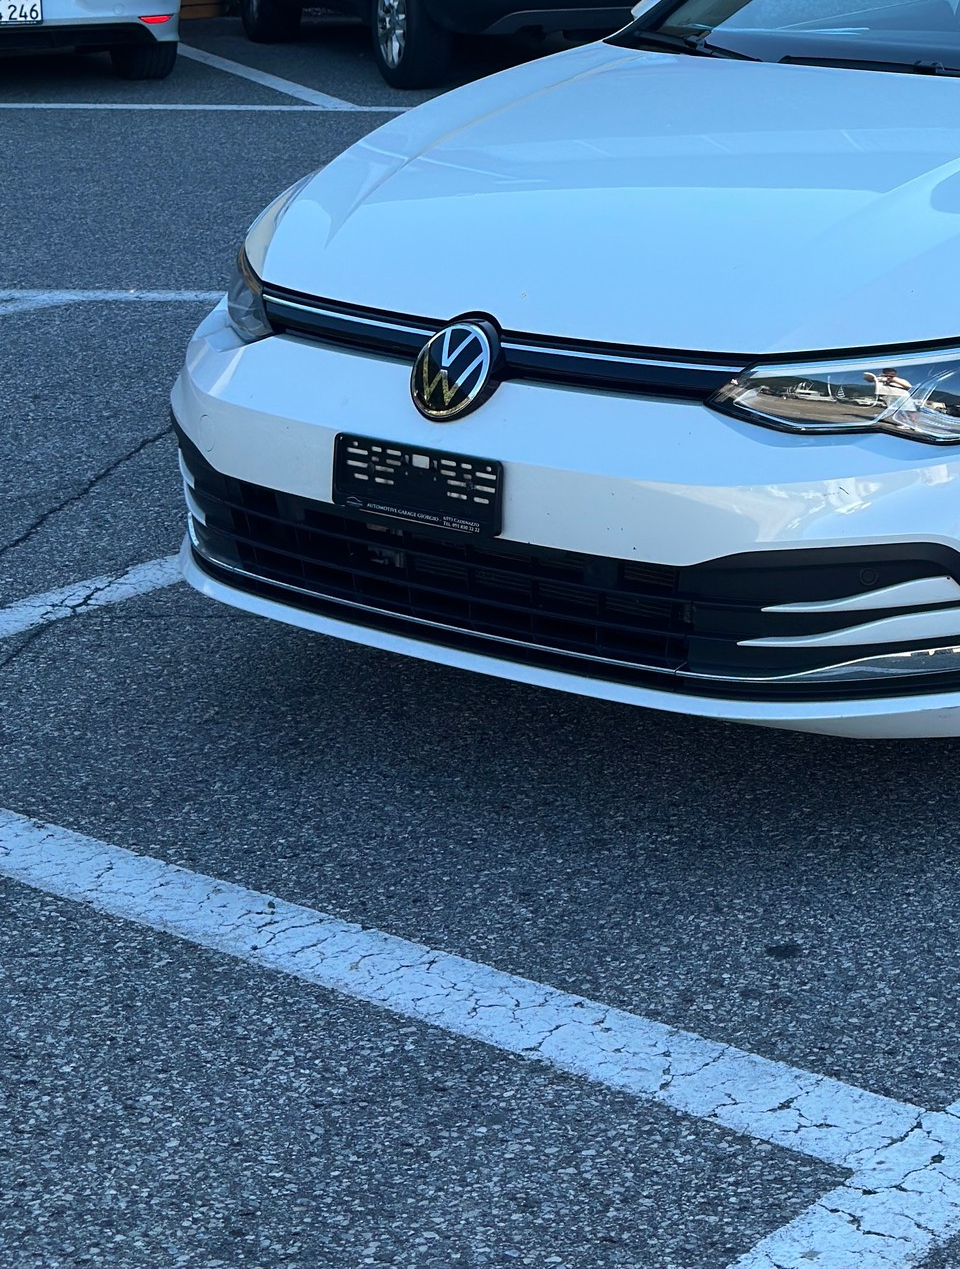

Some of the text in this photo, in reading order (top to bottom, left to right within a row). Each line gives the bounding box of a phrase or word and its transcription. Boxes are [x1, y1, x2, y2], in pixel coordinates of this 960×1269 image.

[8, 4, 39, 21] 246
[366, 503, 398, 514] AUTOMOTIVE
[398, 509, 417, 518] GARAGE
[417, 513, 439, 522] GIORGIO
